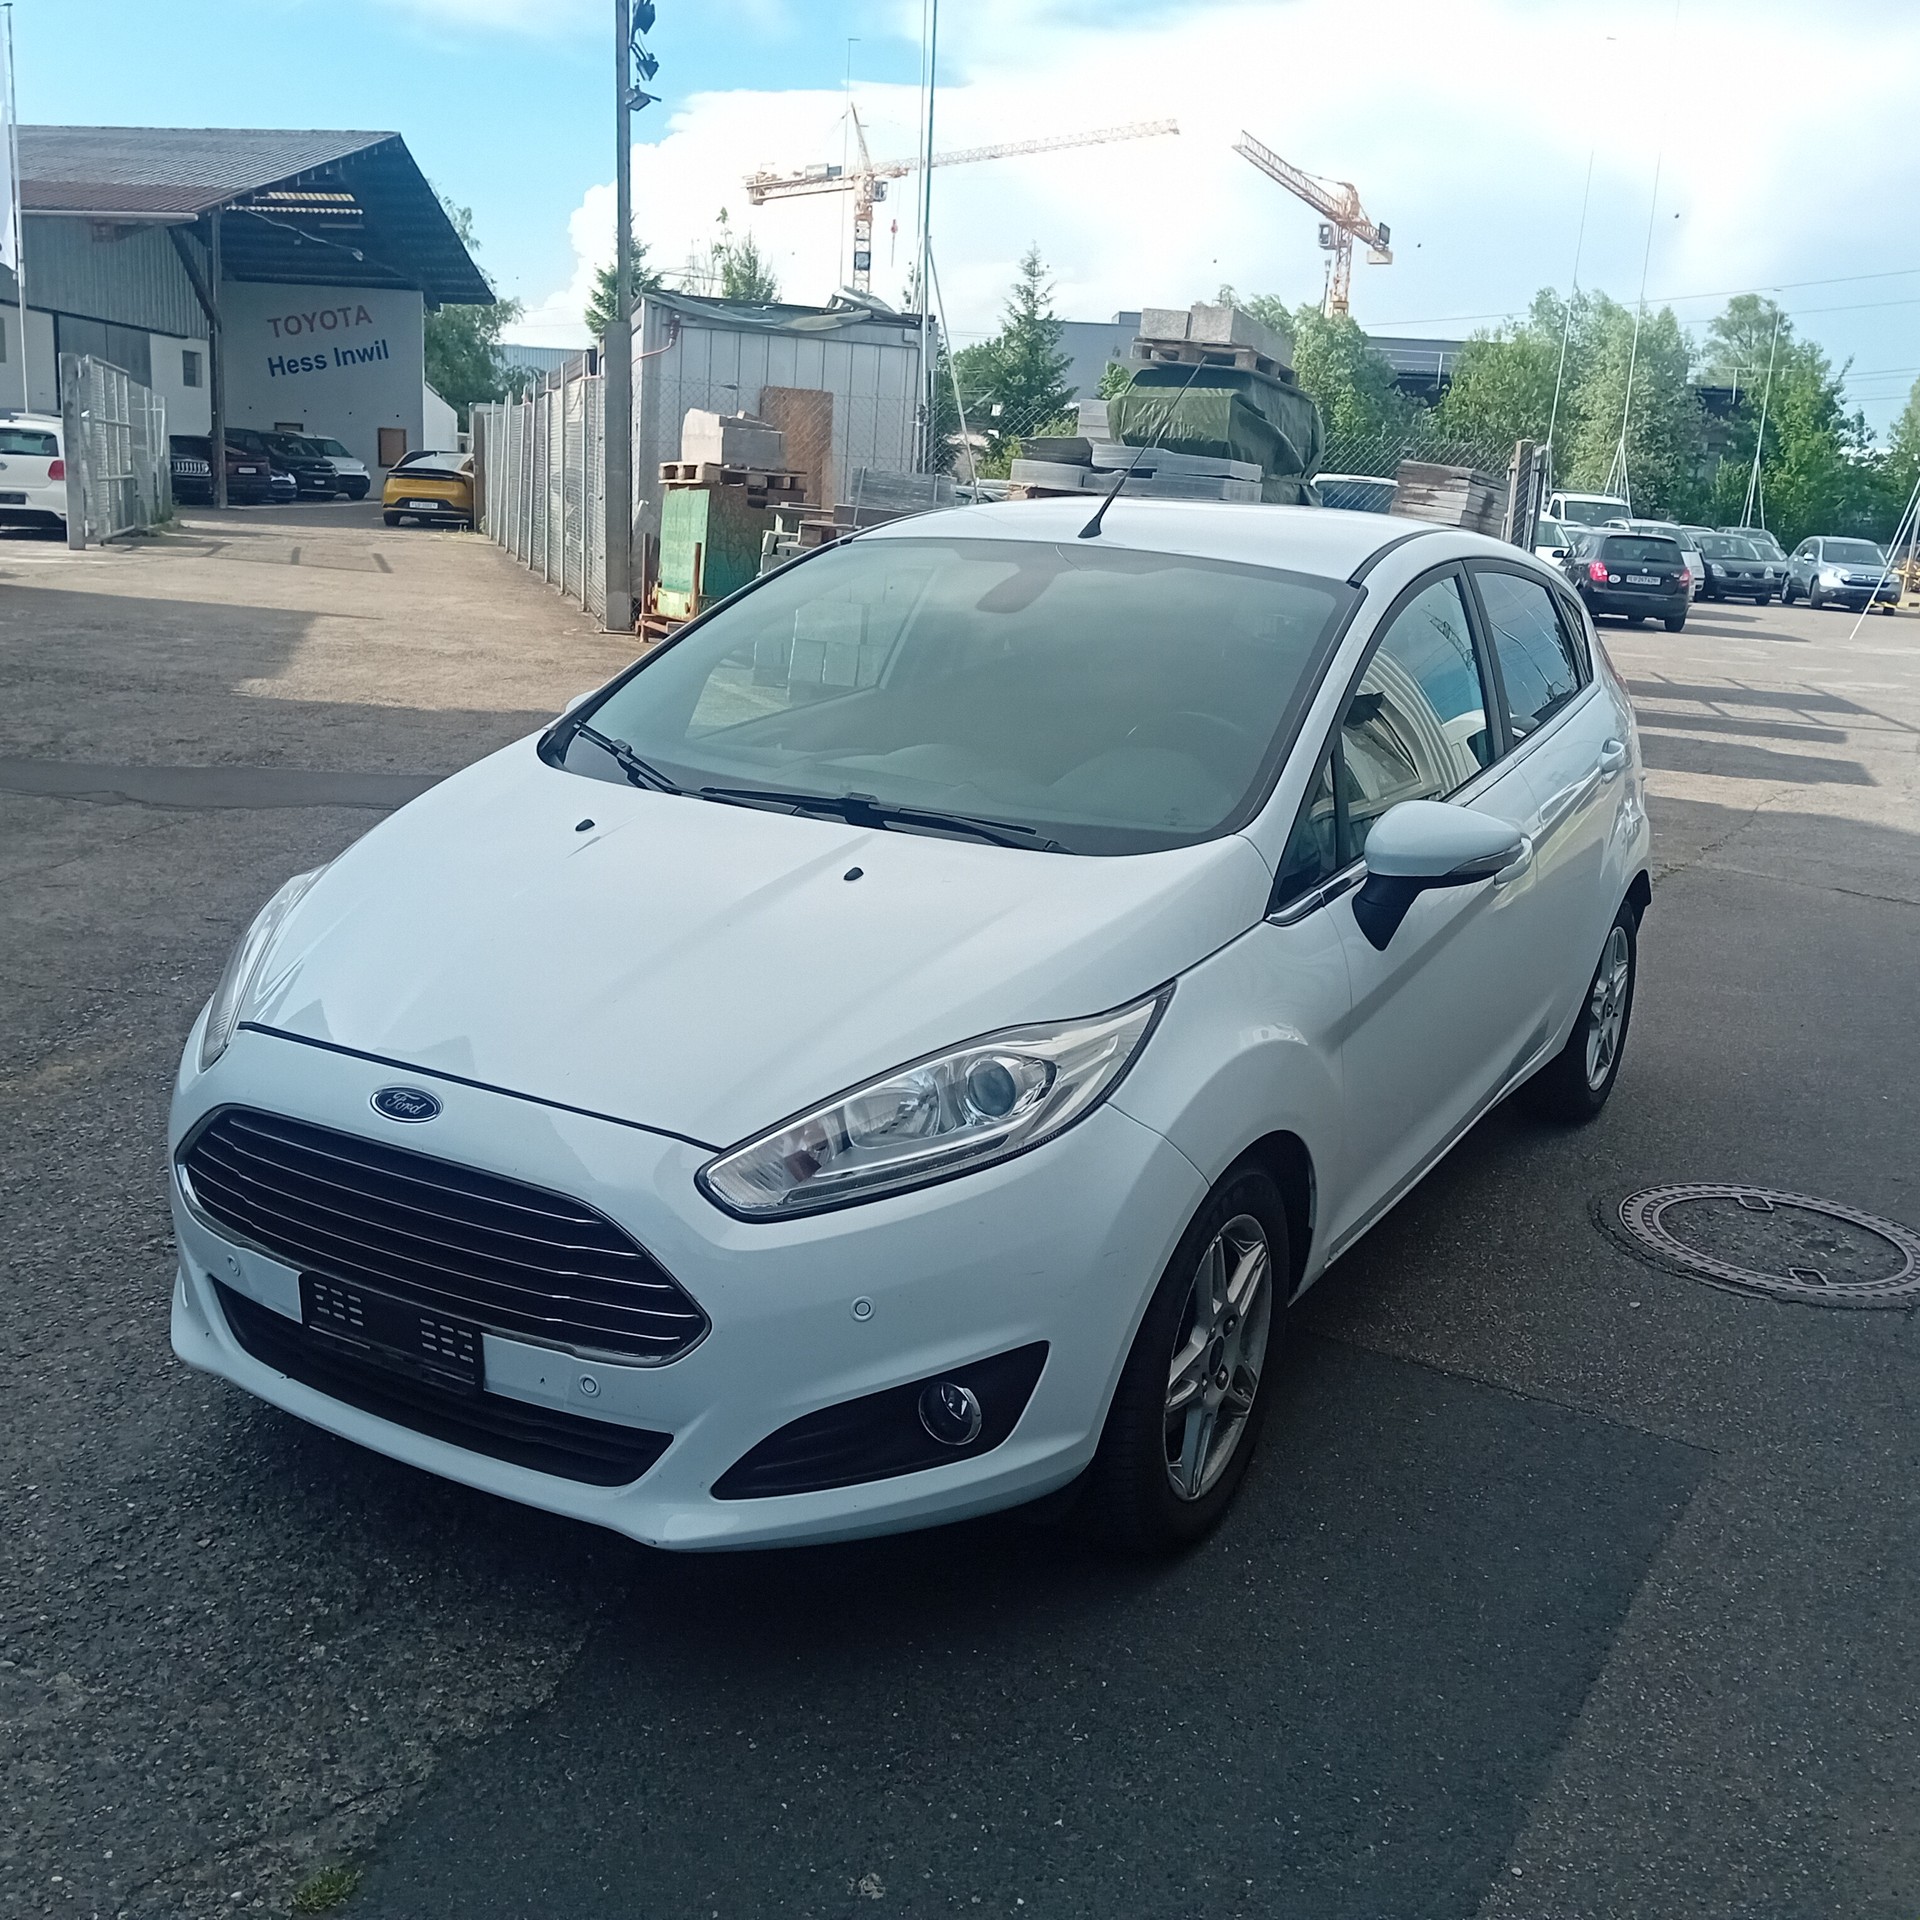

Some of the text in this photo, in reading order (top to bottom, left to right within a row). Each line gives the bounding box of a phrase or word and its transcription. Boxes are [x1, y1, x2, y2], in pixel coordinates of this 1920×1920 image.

[267, 305, 373, 338] TOYOTA
[267, 339, 389, 377] Hess Inwil
[385, 1092, 427, 1115] Ford
